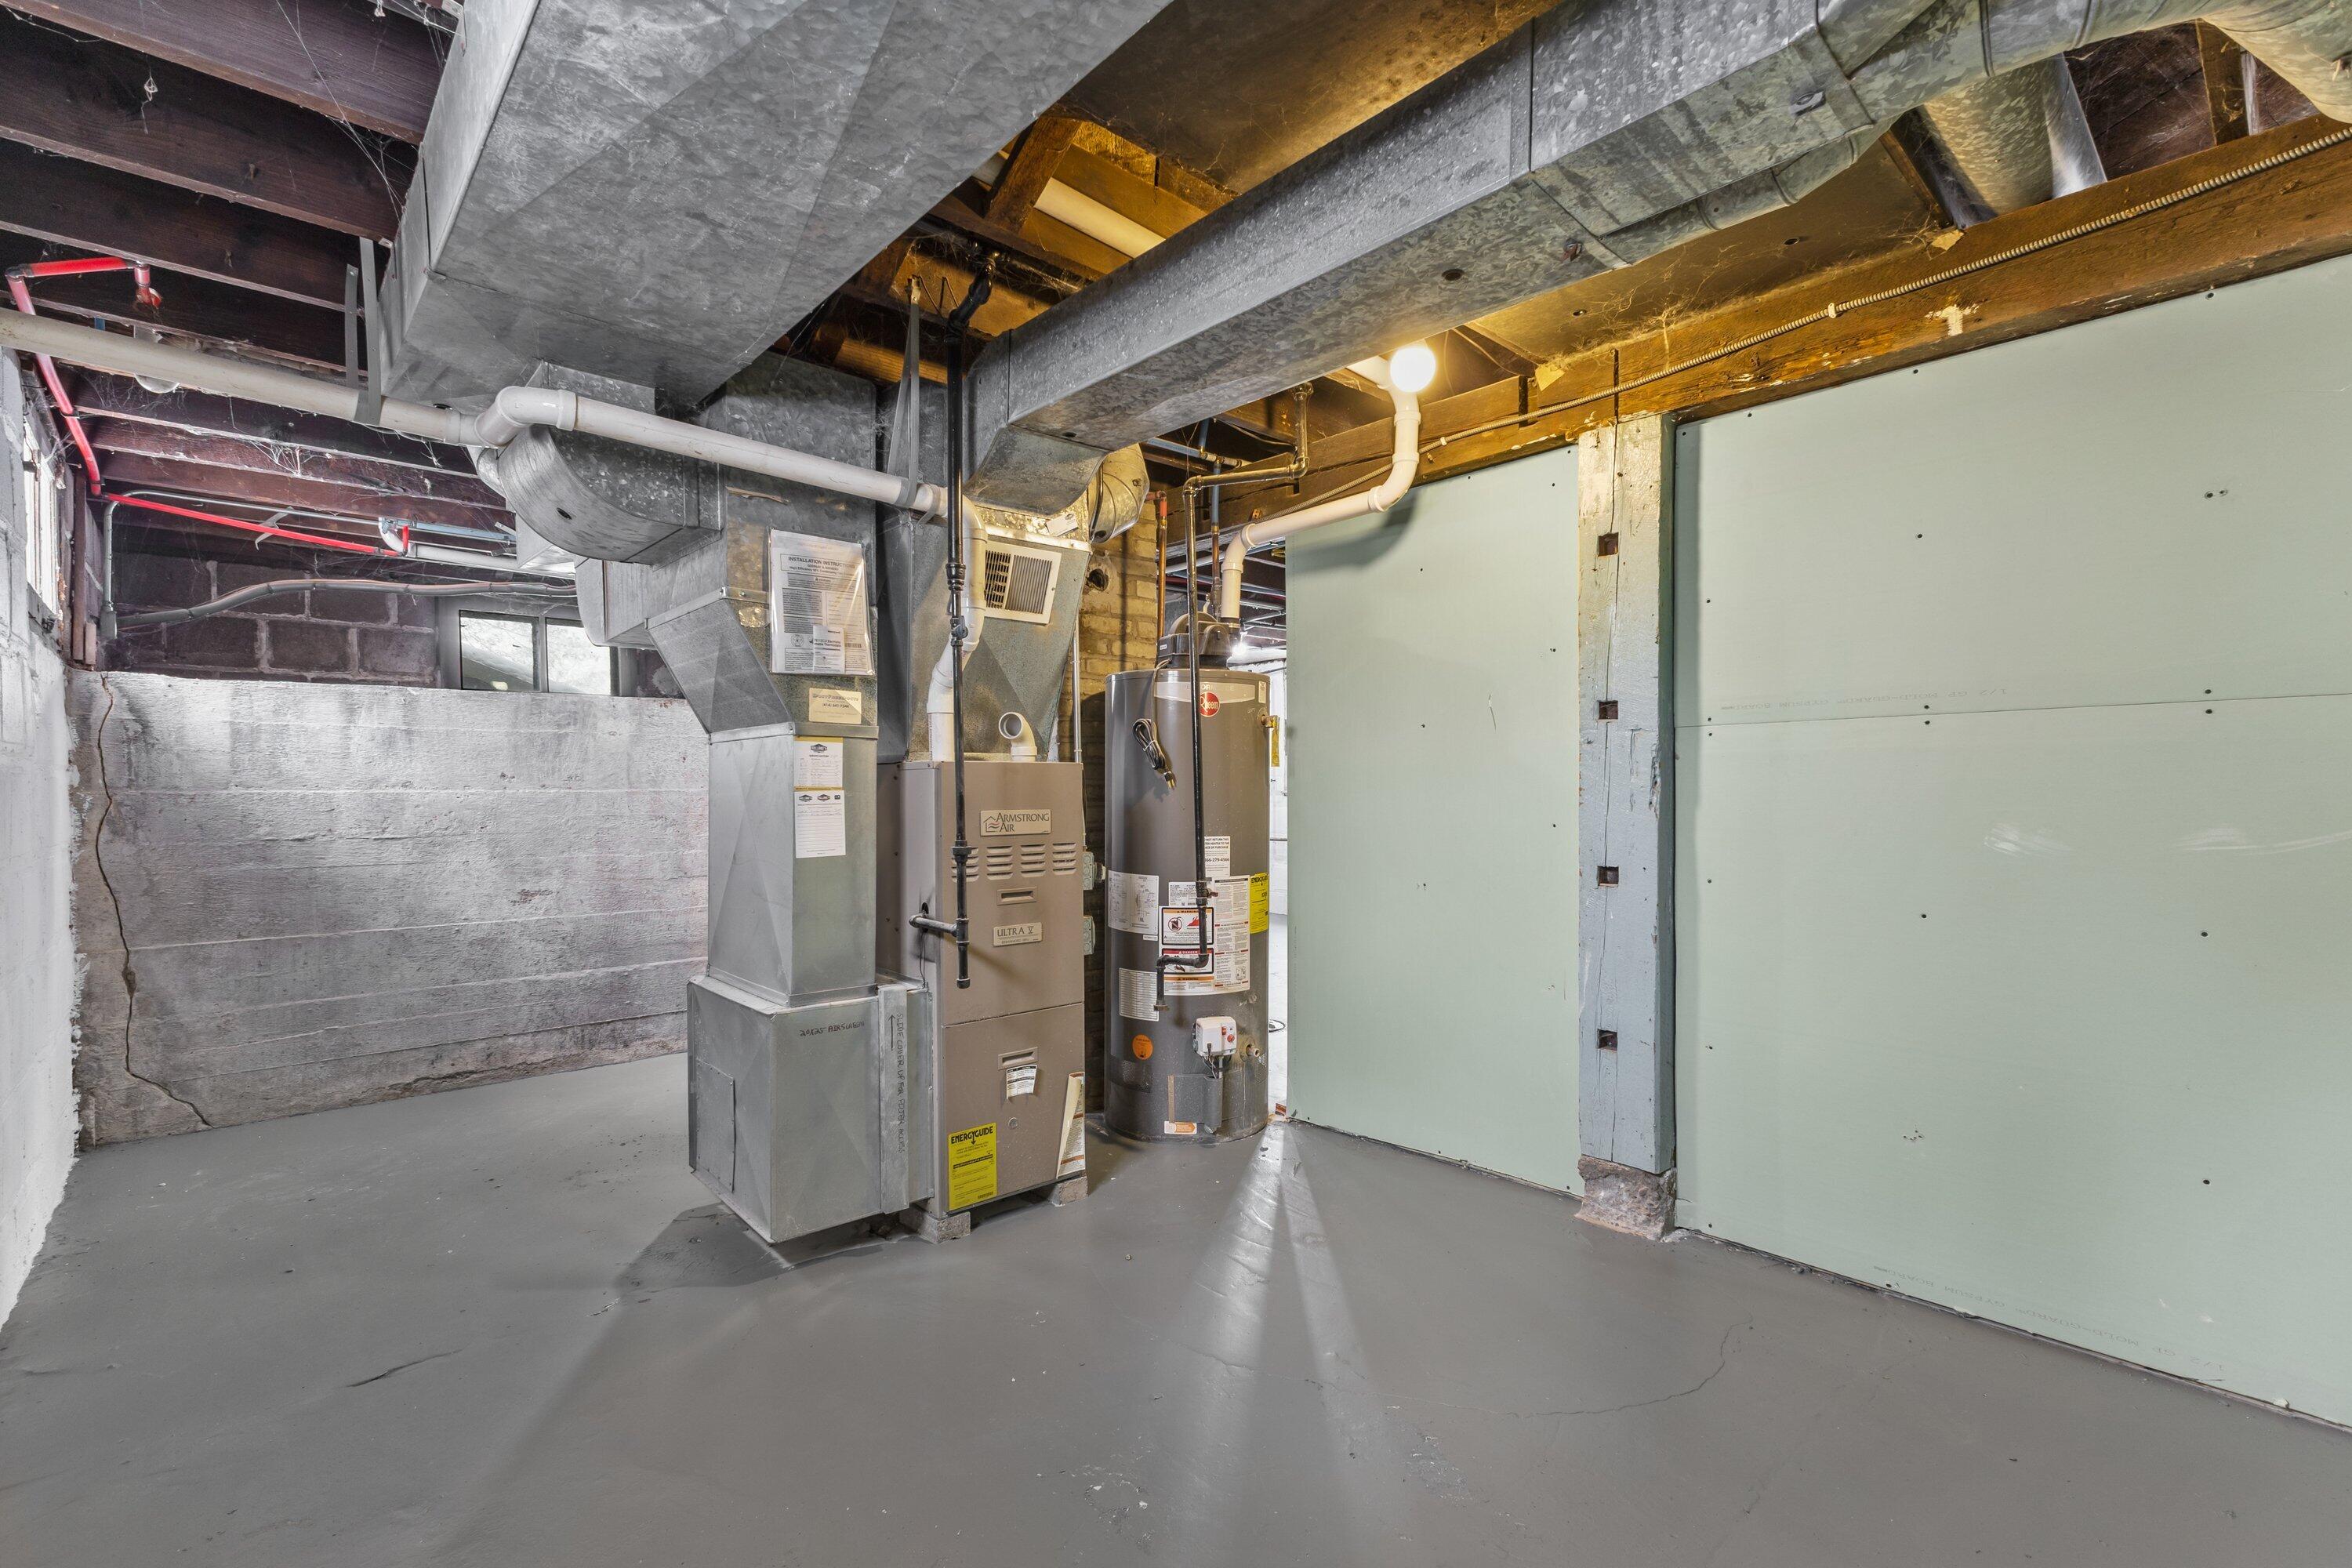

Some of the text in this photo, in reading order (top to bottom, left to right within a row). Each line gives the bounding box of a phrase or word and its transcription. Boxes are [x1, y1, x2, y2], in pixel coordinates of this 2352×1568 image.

[788, 556, 822, 564] INSTALLATION
[996, 812, 1050, 822] ARMSTRONG
[1000, 822, 1015, 833] AIR
[996, 925, 1035, 937] ULTRA V
[951, 1126, 993, 1145] ENERGYGUIDE
